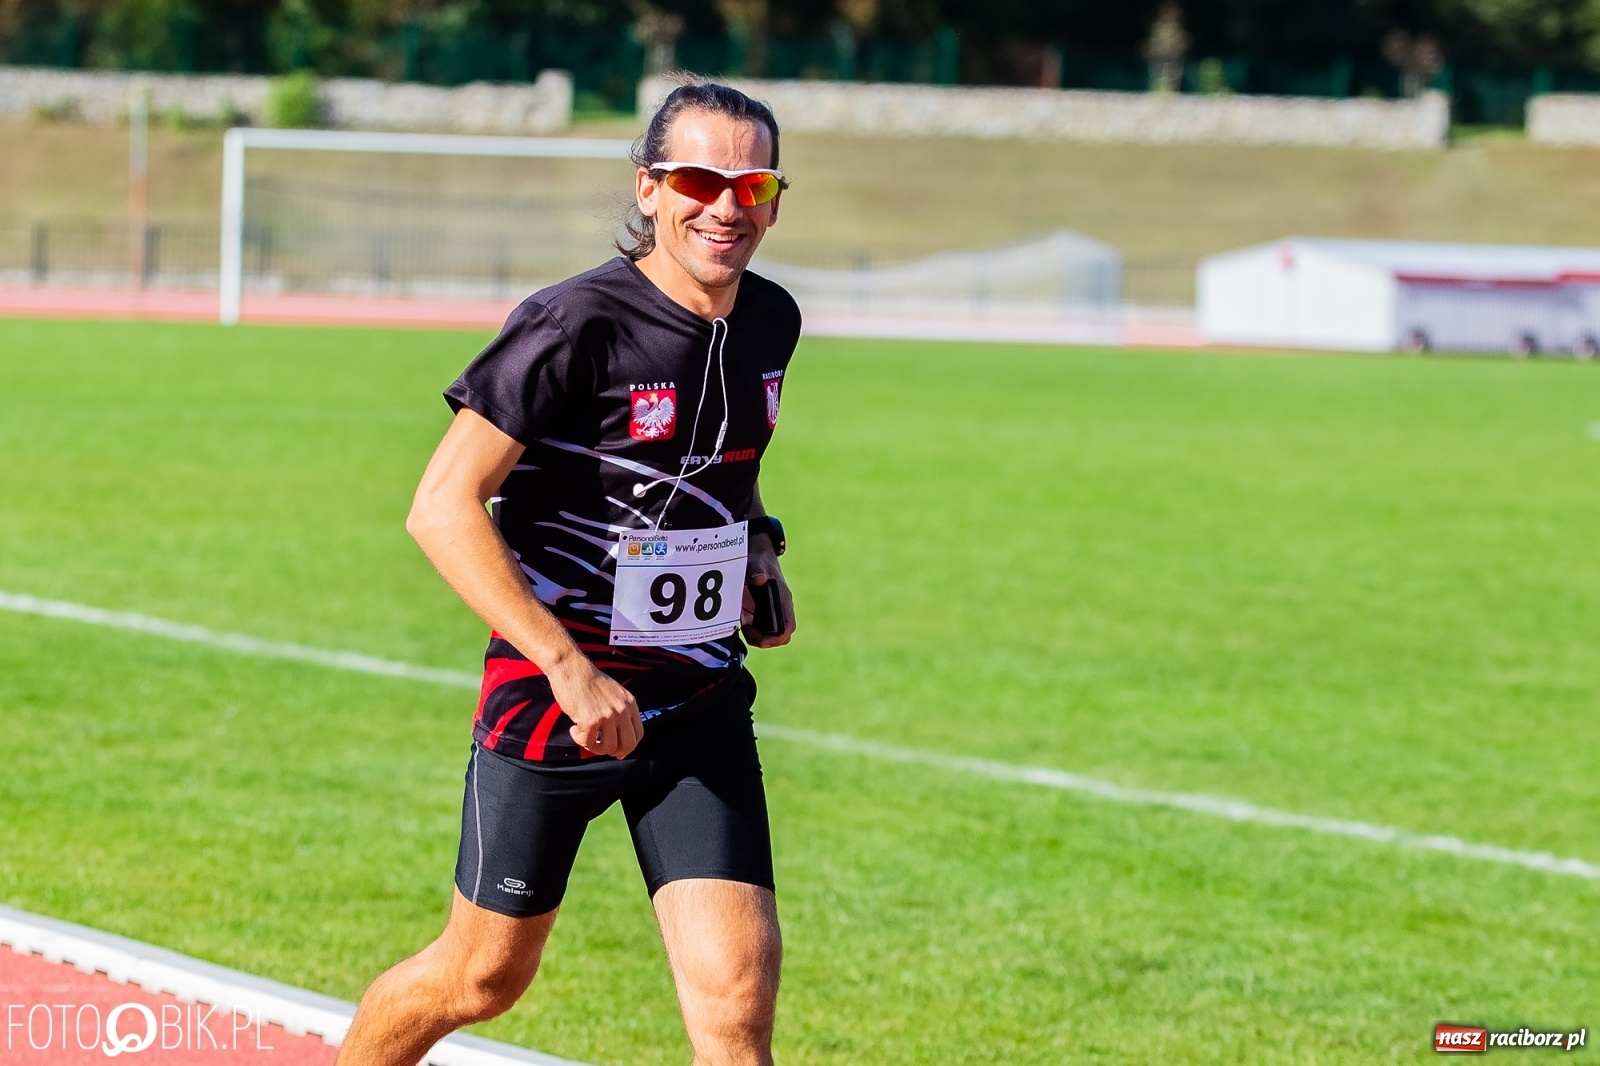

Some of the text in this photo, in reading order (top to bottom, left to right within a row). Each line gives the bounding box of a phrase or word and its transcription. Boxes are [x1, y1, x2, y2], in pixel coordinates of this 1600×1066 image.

[629, 381, 676, 392] POLSKA
[675, 535, 745, 553] www.personalbest.pl
[649, 569, 723, 625] 98
[496, 883, 534, 897] Kalenji
